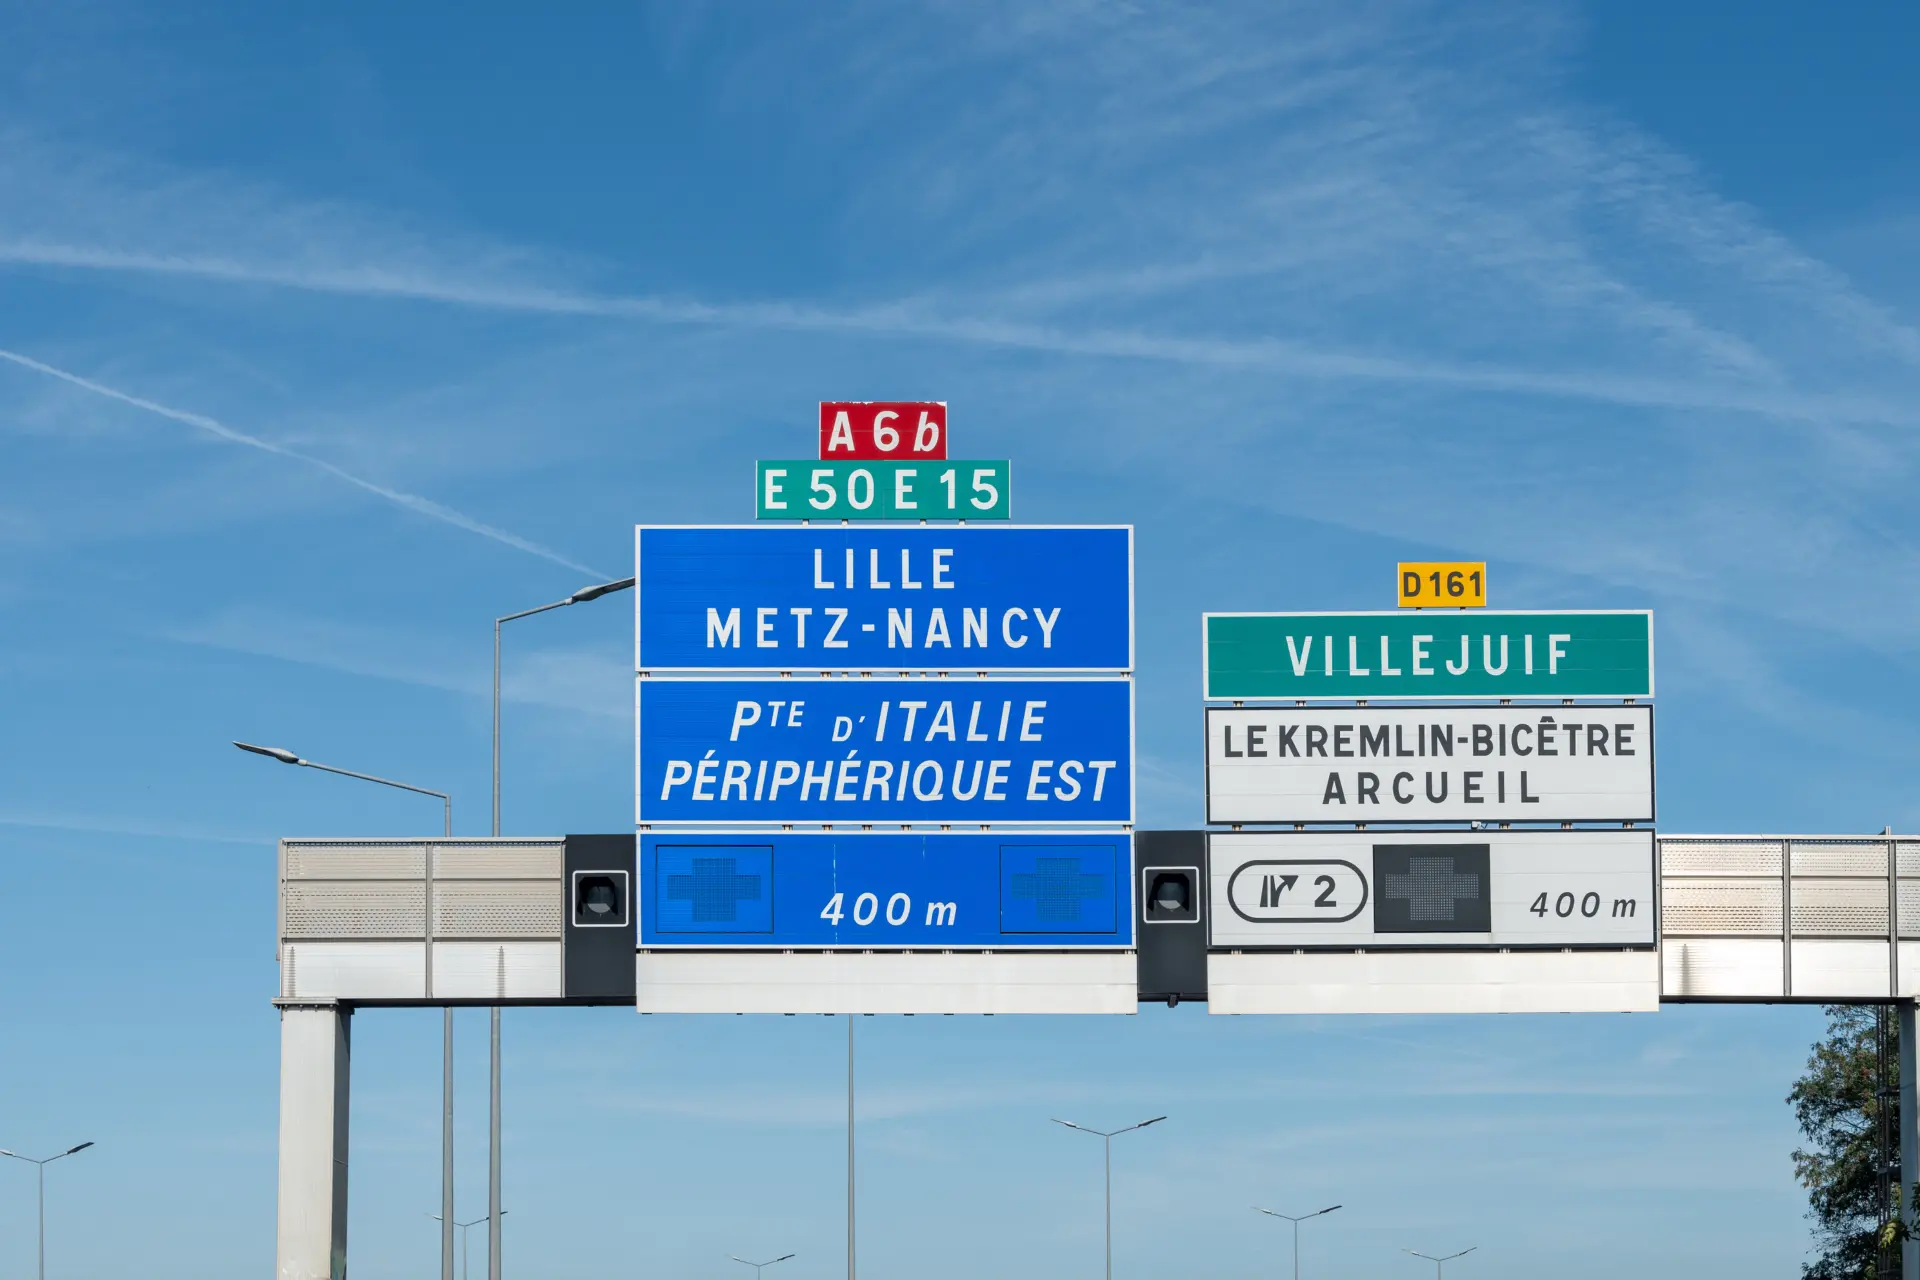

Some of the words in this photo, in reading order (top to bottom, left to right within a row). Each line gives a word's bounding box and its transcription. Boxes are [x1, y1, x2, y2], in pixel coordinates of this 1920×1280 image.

[764, 469, 788, 510] E
[808, 468, 875, 511] 50
[895, 469, 918, 510] E
[940, 468, 999, 511] 15
[814, 548, 955, 589] LILLE
[706, 607, 1062, 649] METZ-NANCY
[1285, 633, 1571, 677] VILLEJUIF
[1224, 725, 1268, 758] LE
[1278, 715, 1636, 758] KREMLIN-BICÊTRE
[660, 749, 1012, 802] PÉRIPHÉRIQUE
[1026, 759, 1117, 802] EST
[1322, 770, 1540, 805] ARCUEIL
[820, 892, 911, 926] 400
[925, 901, 957, 926] m
[1313, 874, 1337, 908] 2
[1529, 891, 1601, 918] 400
[1611, 898, 1637, 918] m
